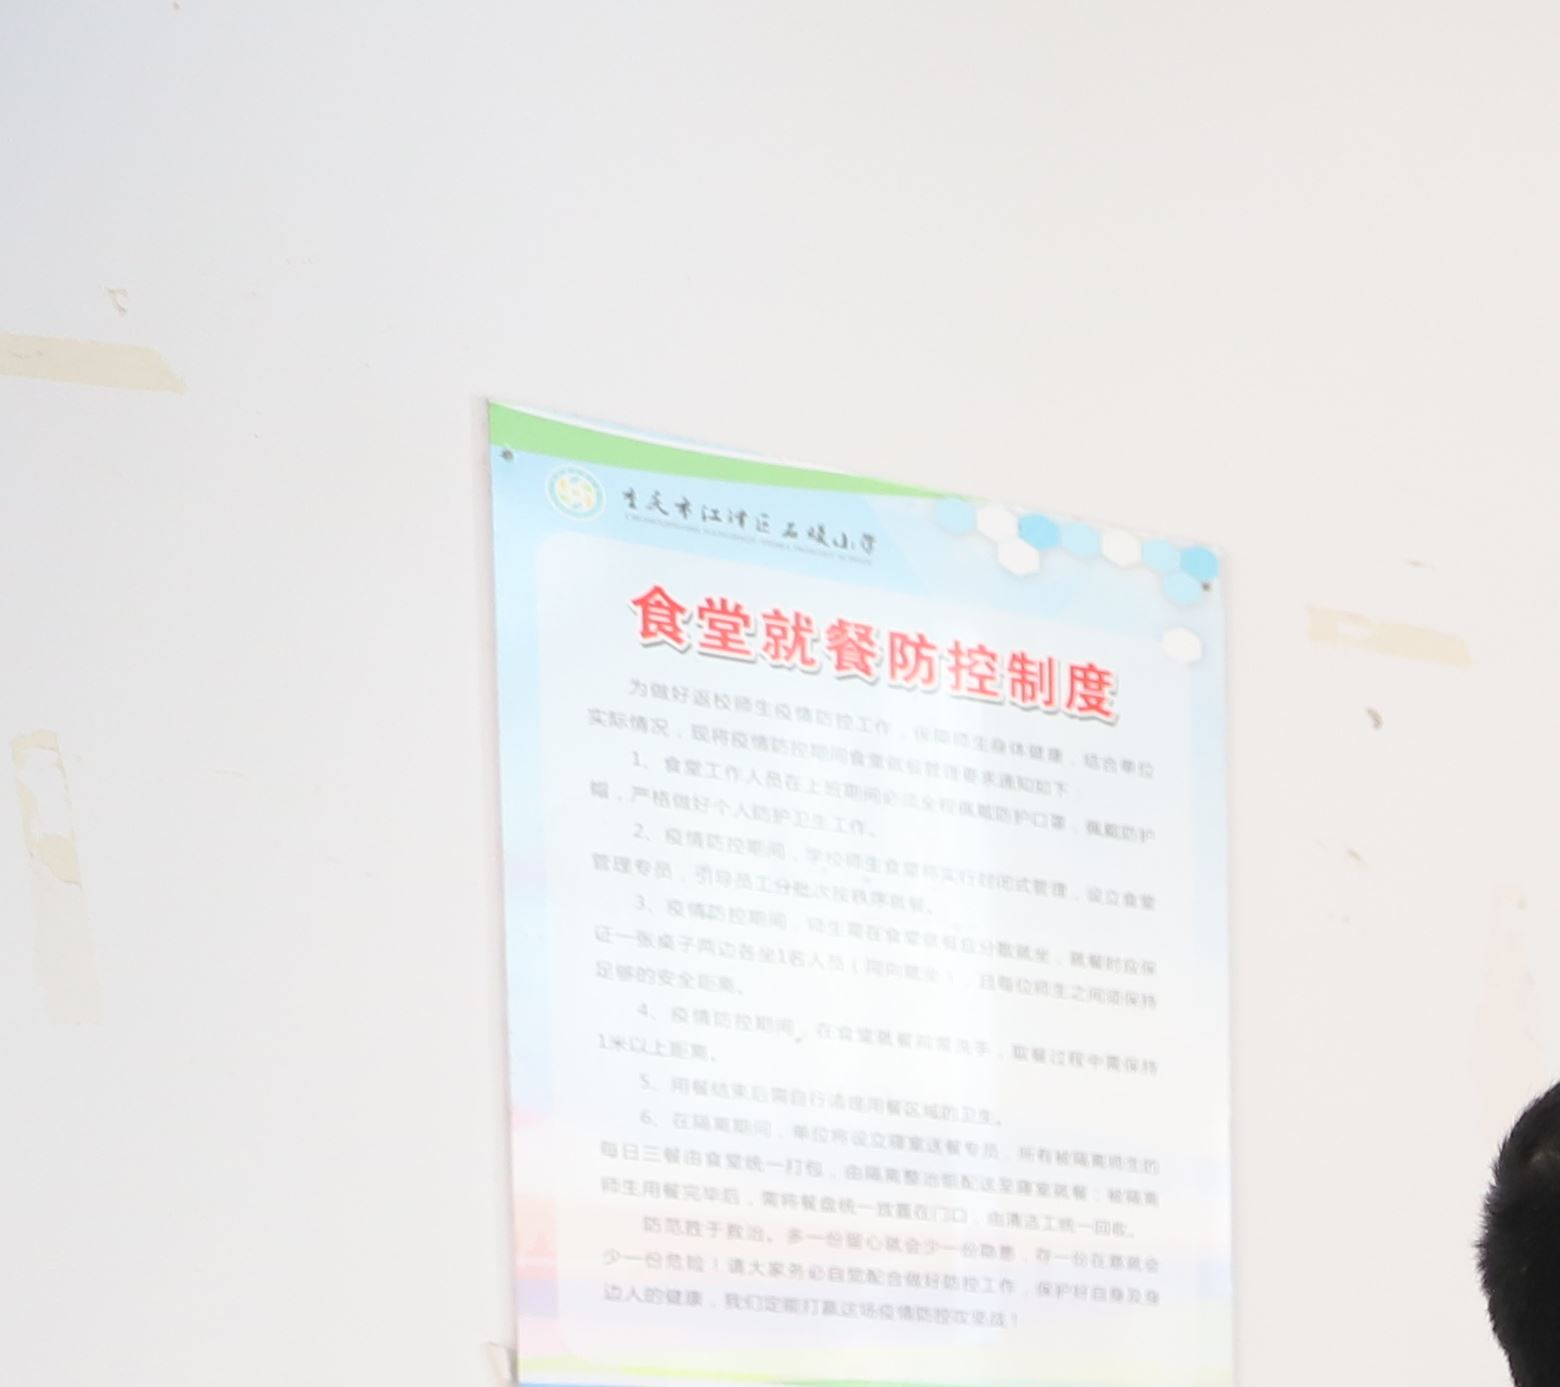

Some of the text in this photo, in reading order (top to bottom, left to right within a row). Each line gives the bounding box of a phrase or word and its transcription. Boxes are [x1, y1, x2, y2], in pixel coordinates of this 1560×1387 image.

[630, 584, 1117, 720] 食堂就餐防控制度
